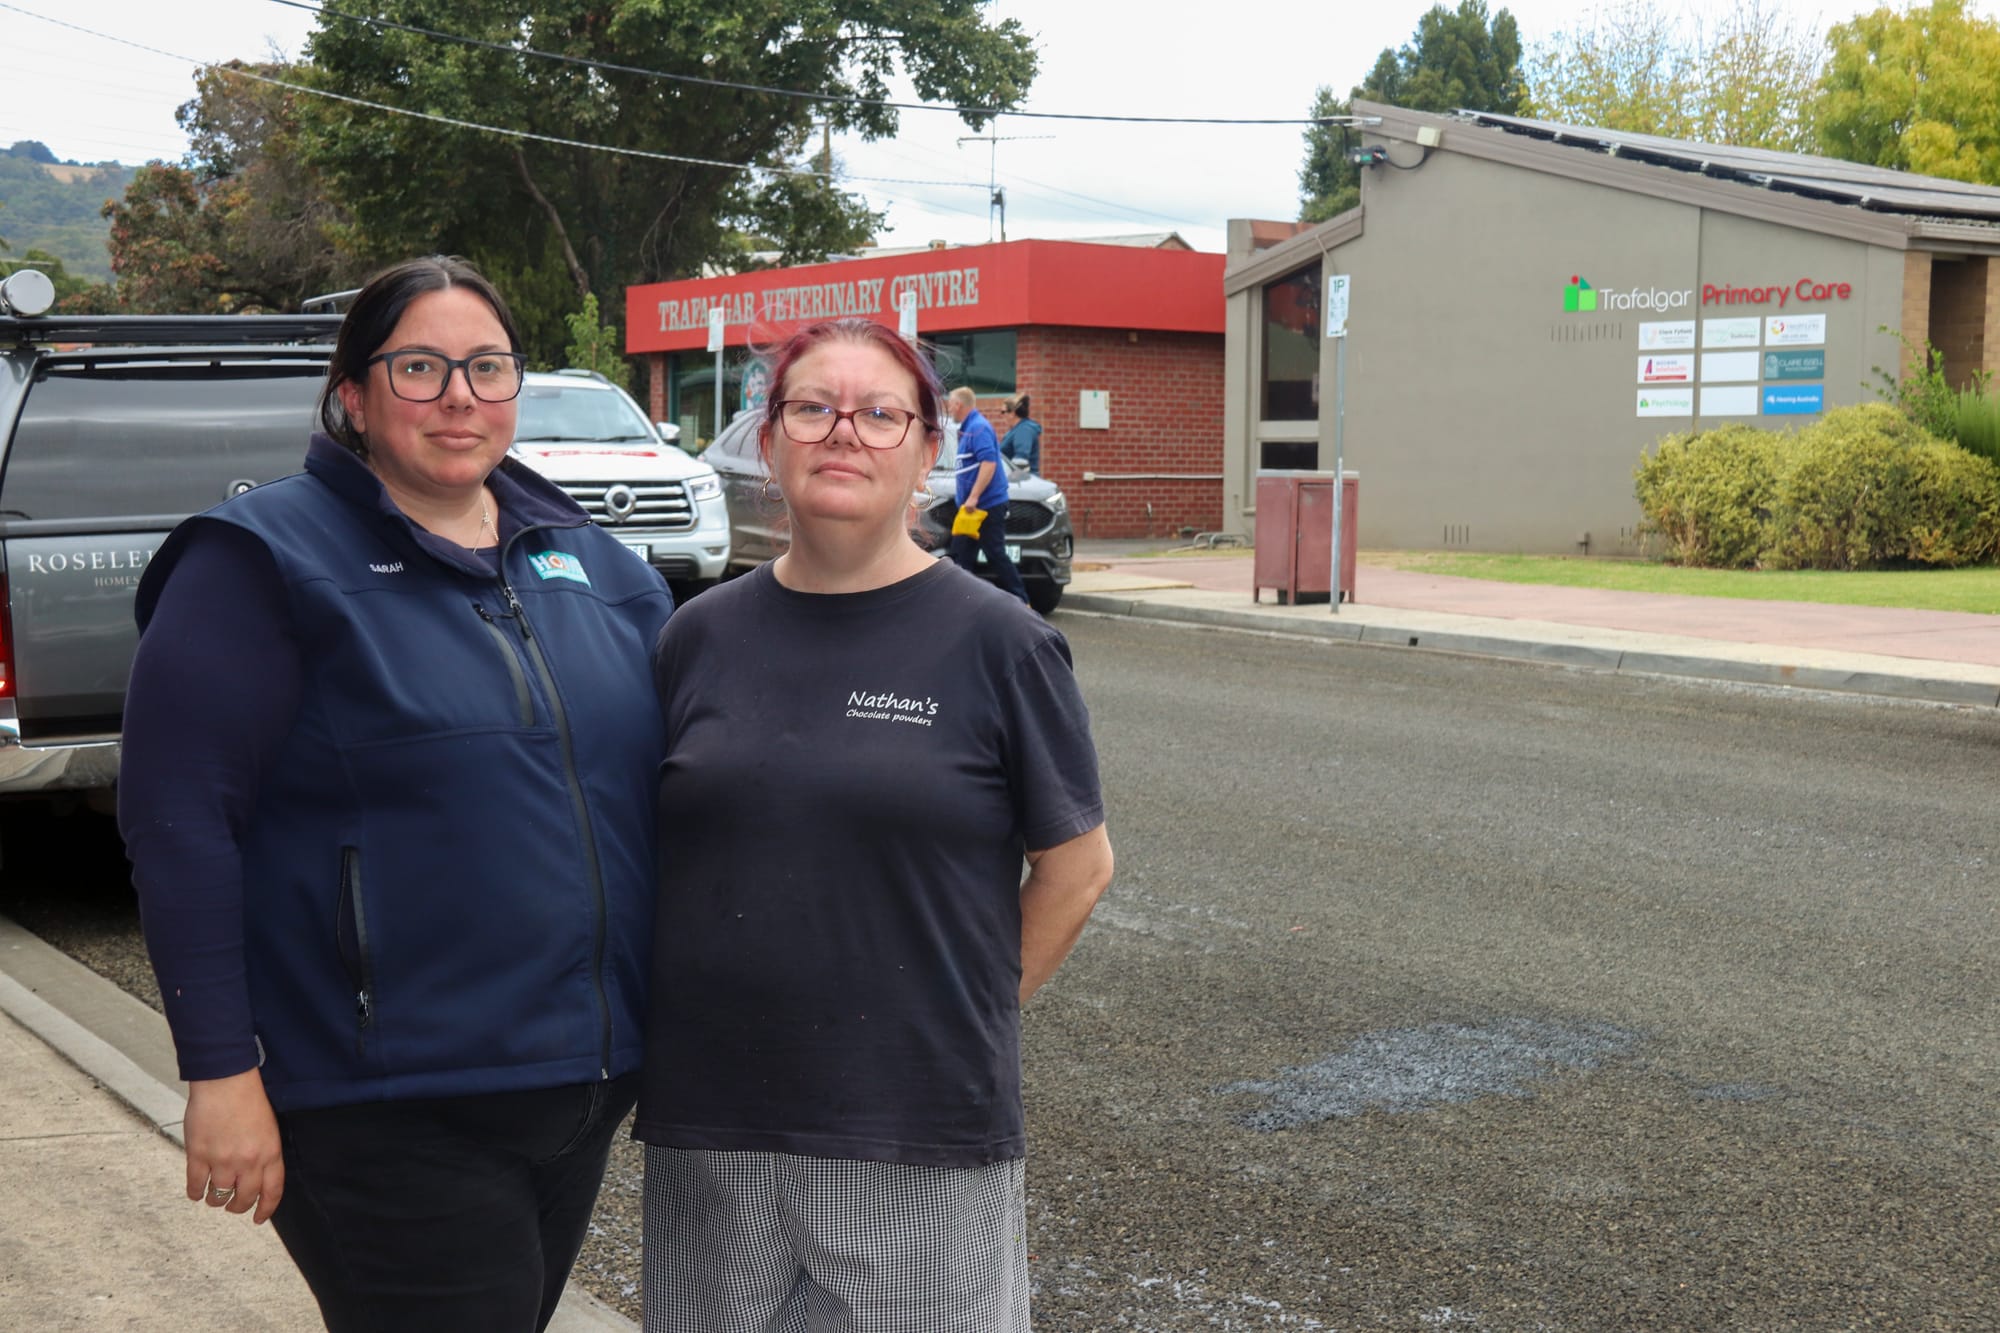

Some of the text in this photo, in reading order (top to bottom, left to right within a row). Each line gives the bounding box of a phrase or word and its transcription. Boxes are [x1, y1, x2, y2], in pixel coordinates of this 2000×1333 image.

[762, 278, 884, 321] VETERINARY
[1600, 278, 1852, 313] Trafalgar Primary Care
[369, 561, 404, 574] SARAH
[95, 576, 139, 587] HOMES
[847, 691, 939, 715] Nathan's
[846, 709, 932, 726] Chocolate powders
